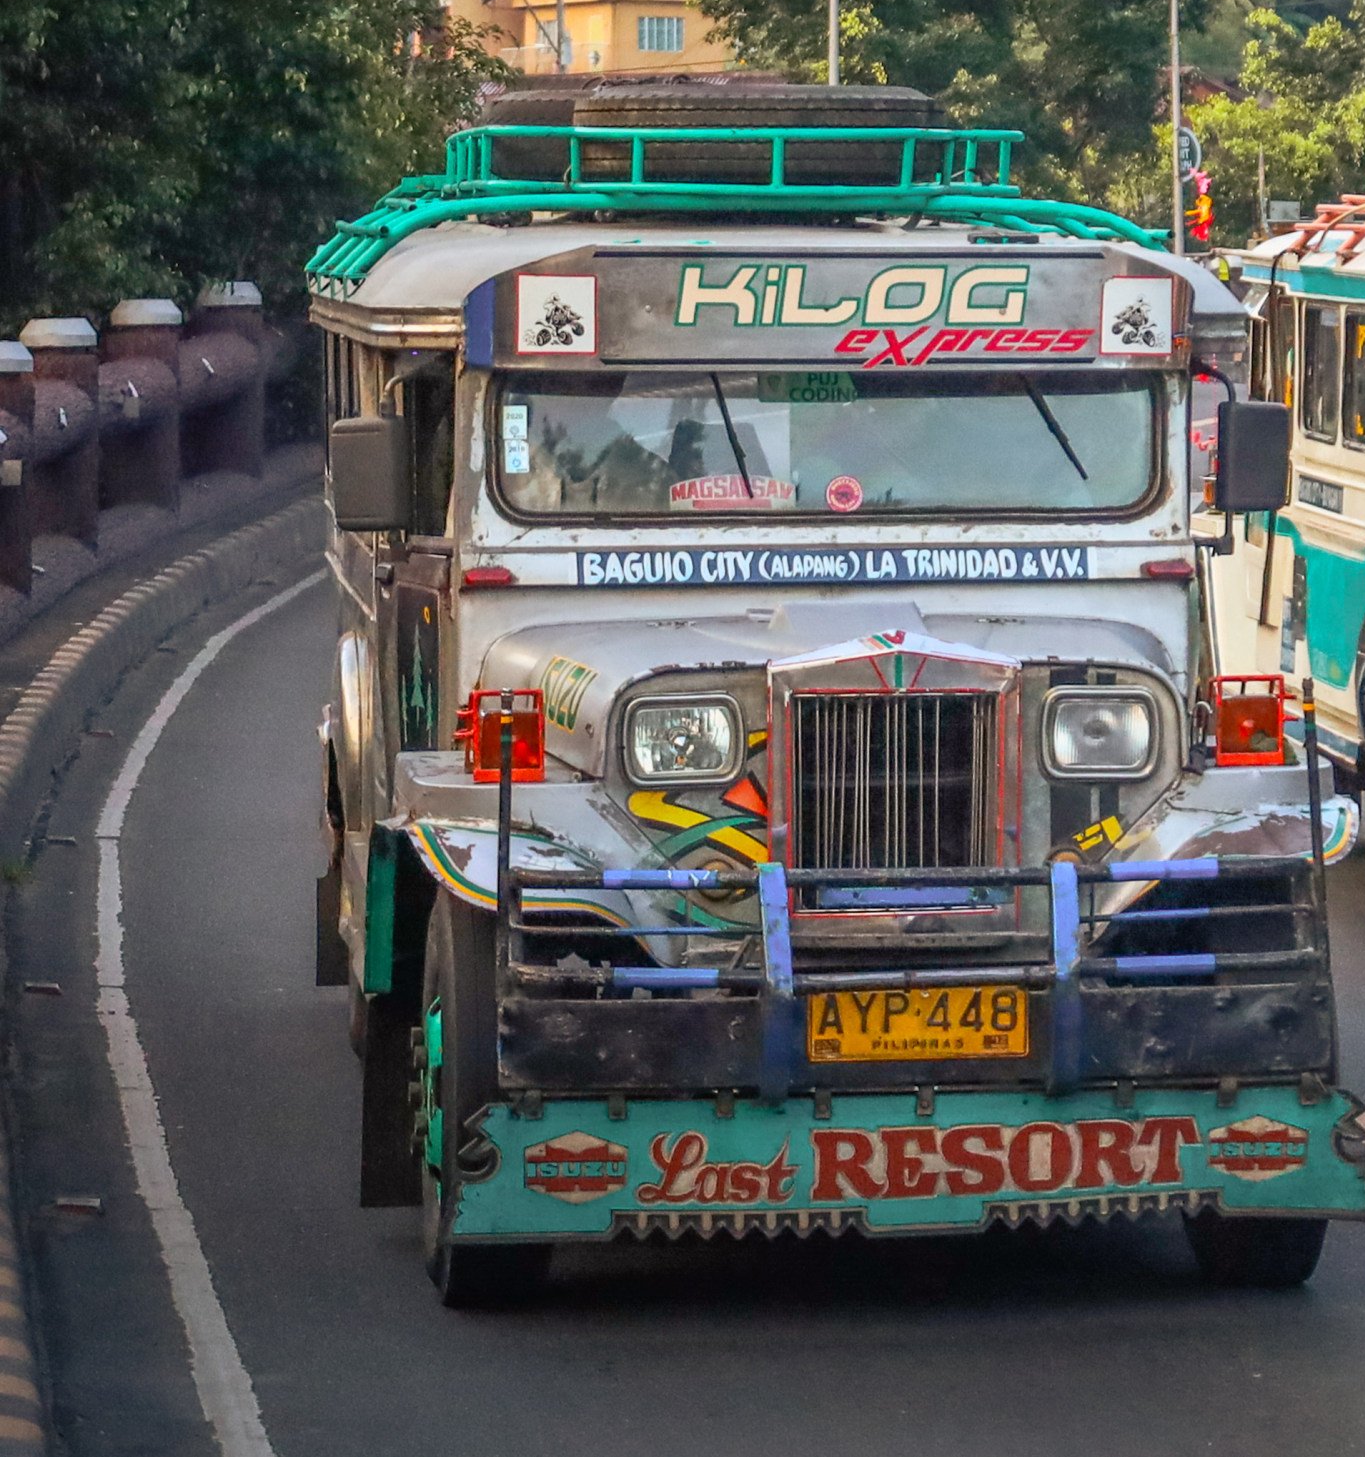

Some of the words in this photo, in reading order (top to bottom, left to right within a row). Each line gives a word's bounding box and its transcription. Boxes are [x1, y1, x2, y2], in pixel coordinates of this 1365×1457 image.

[583, 550, 693, 585] BAGUIO
[700, 550, 754, 583] CITY
[758, 550, 861, 581] (ALAPANG)
[865, 550, 897, 579] LA
[901, 548, 1018, 579] TRINIDAD
[1021, 552, 1039, 578] &
[1040, 548, 1085, 579] V.V.
[871, 1037, 964, 1051] PILIPINAS
[1210, 1141, 1305, 1158] ISUZU
[636, 1129, 800, 1205] Last
[810, 1115, 1203, 1202] RESORT
[526, 1161, 625, 1178] ISUZU
